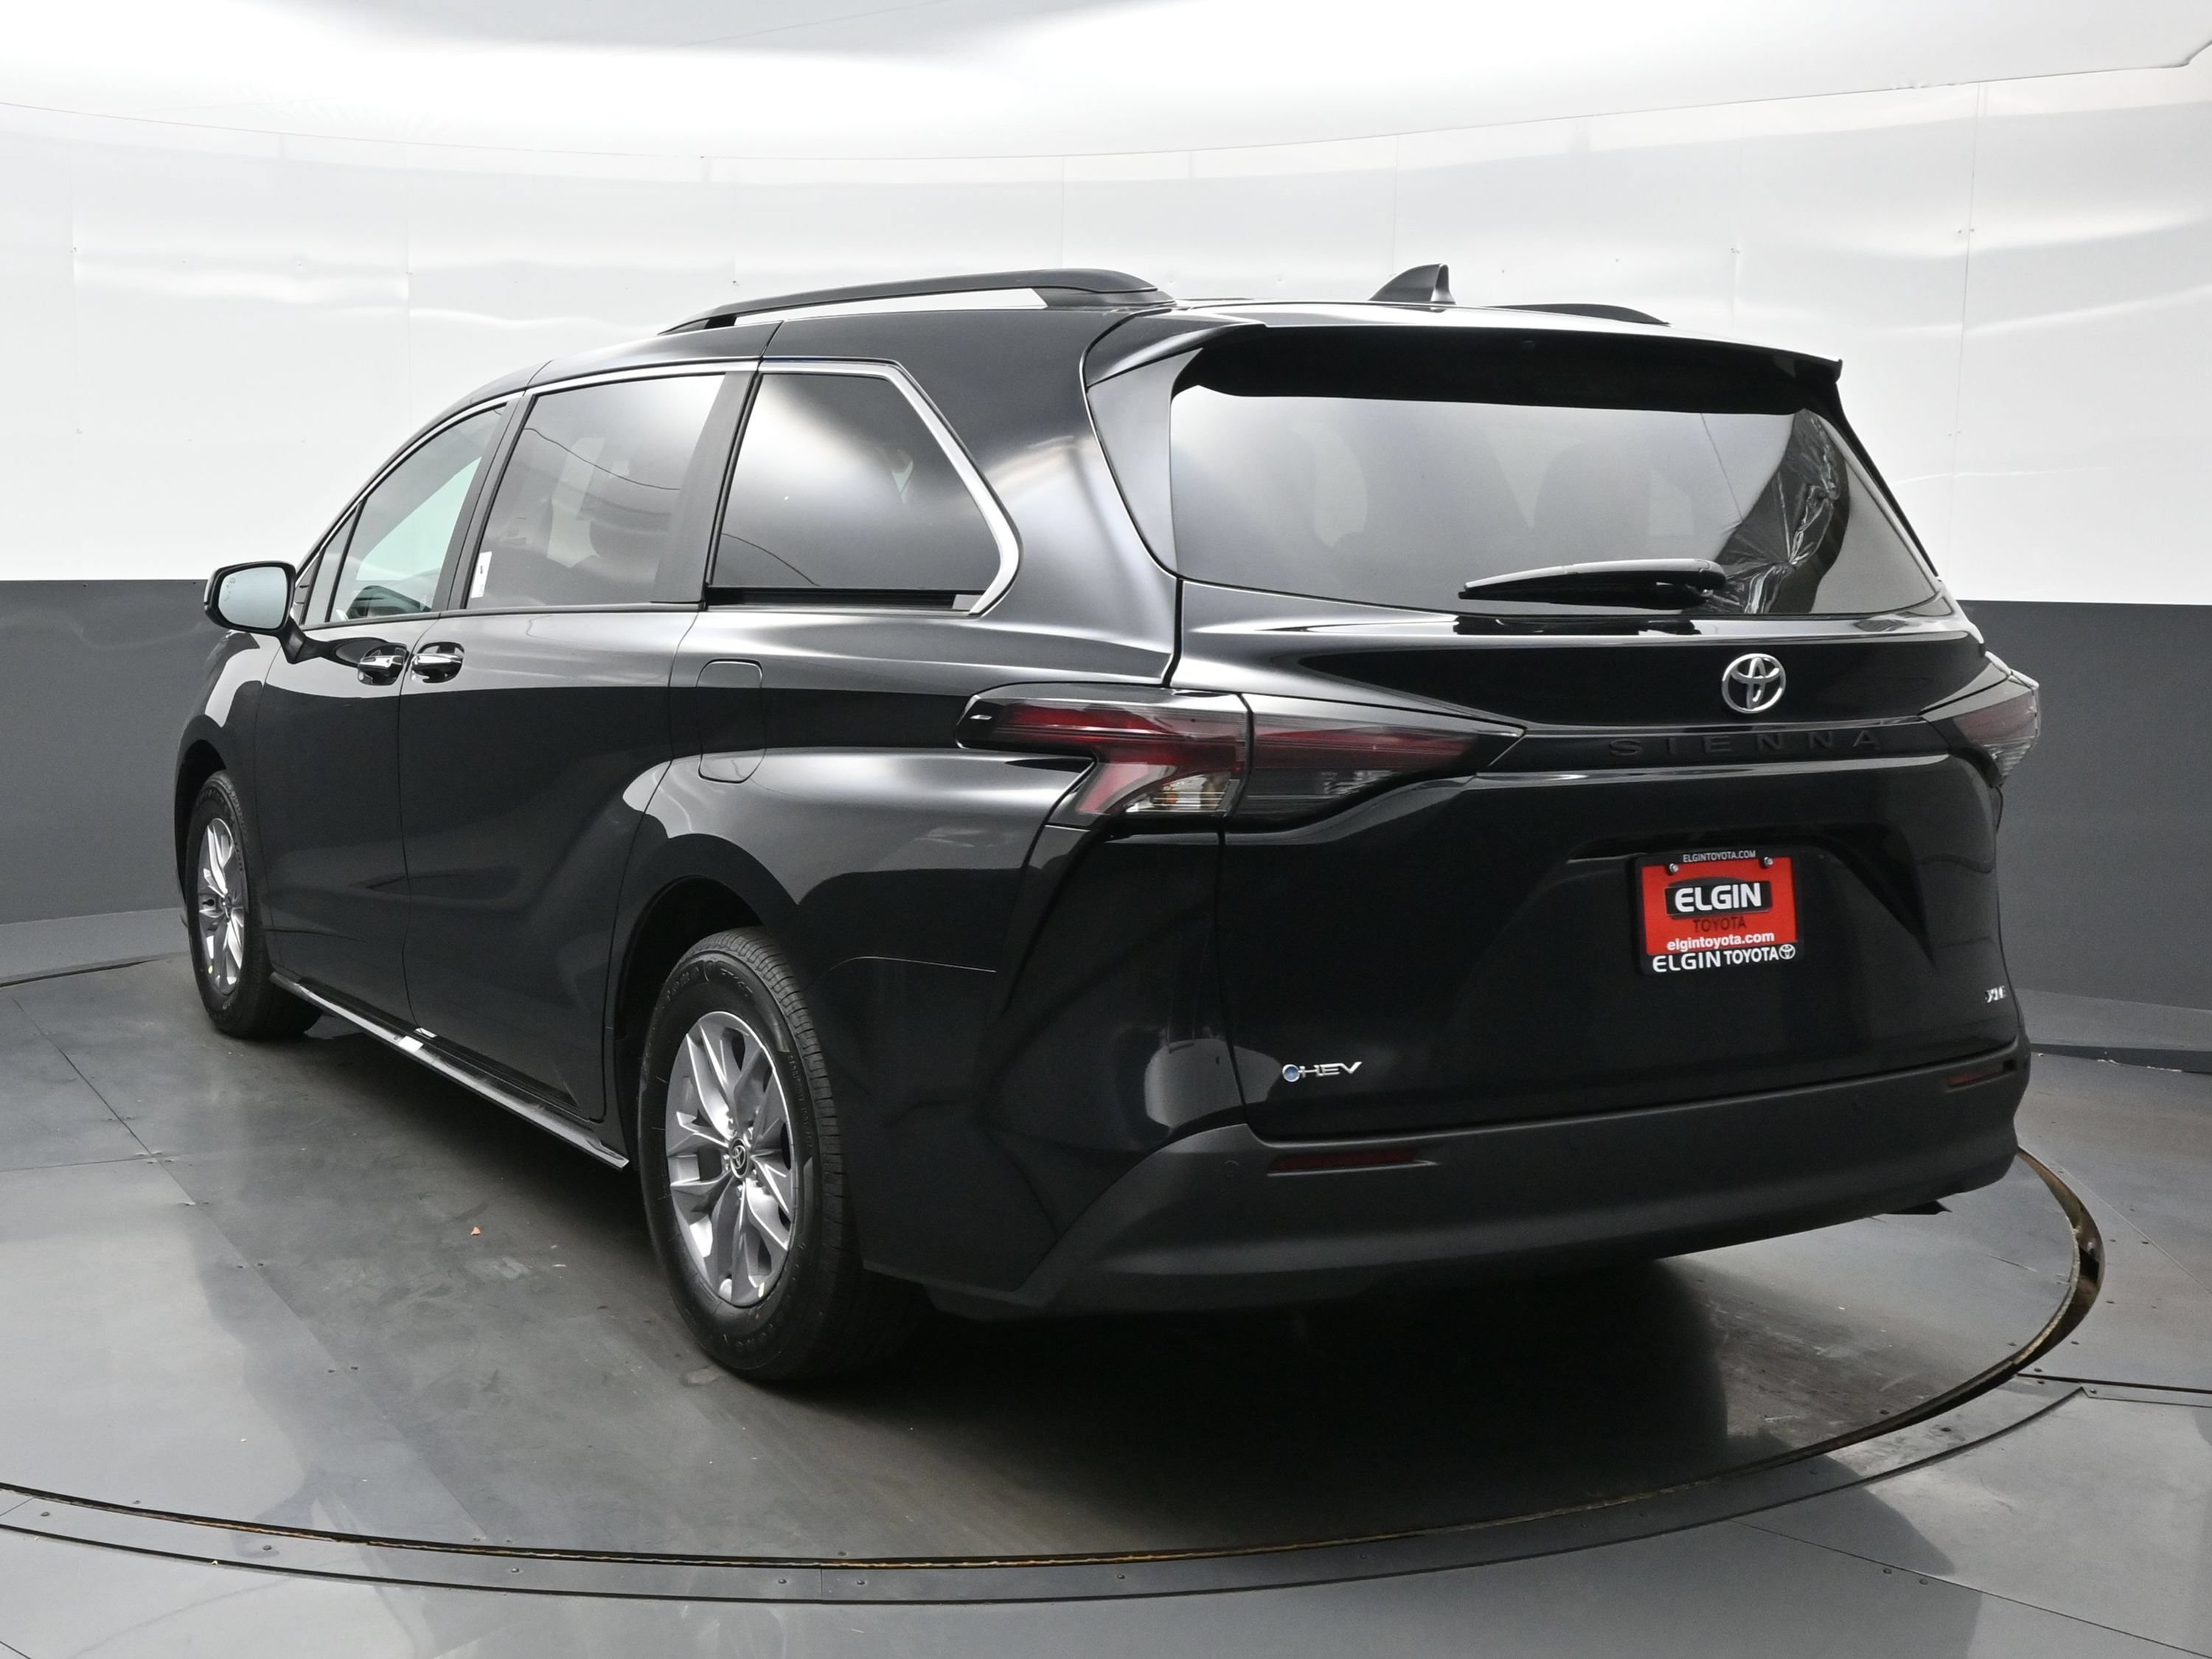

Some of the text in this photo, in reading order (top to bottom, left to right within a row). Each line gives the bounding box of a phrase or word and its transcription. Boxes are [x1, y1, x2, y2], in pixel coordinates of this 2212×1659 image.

[1609, 729, 1880, 757] SIENNA
[1683, 850, 1756, 863] ELGINTOYOTA.COM
[1674, 883, 1761, 912] ELGIN
[1693, 916, 1747, 933] TOYOTA
[1666, 932, 1775, 953] elgintoyota.com
[1652, 947, 1779, 973] ELGIN TOYOTA
